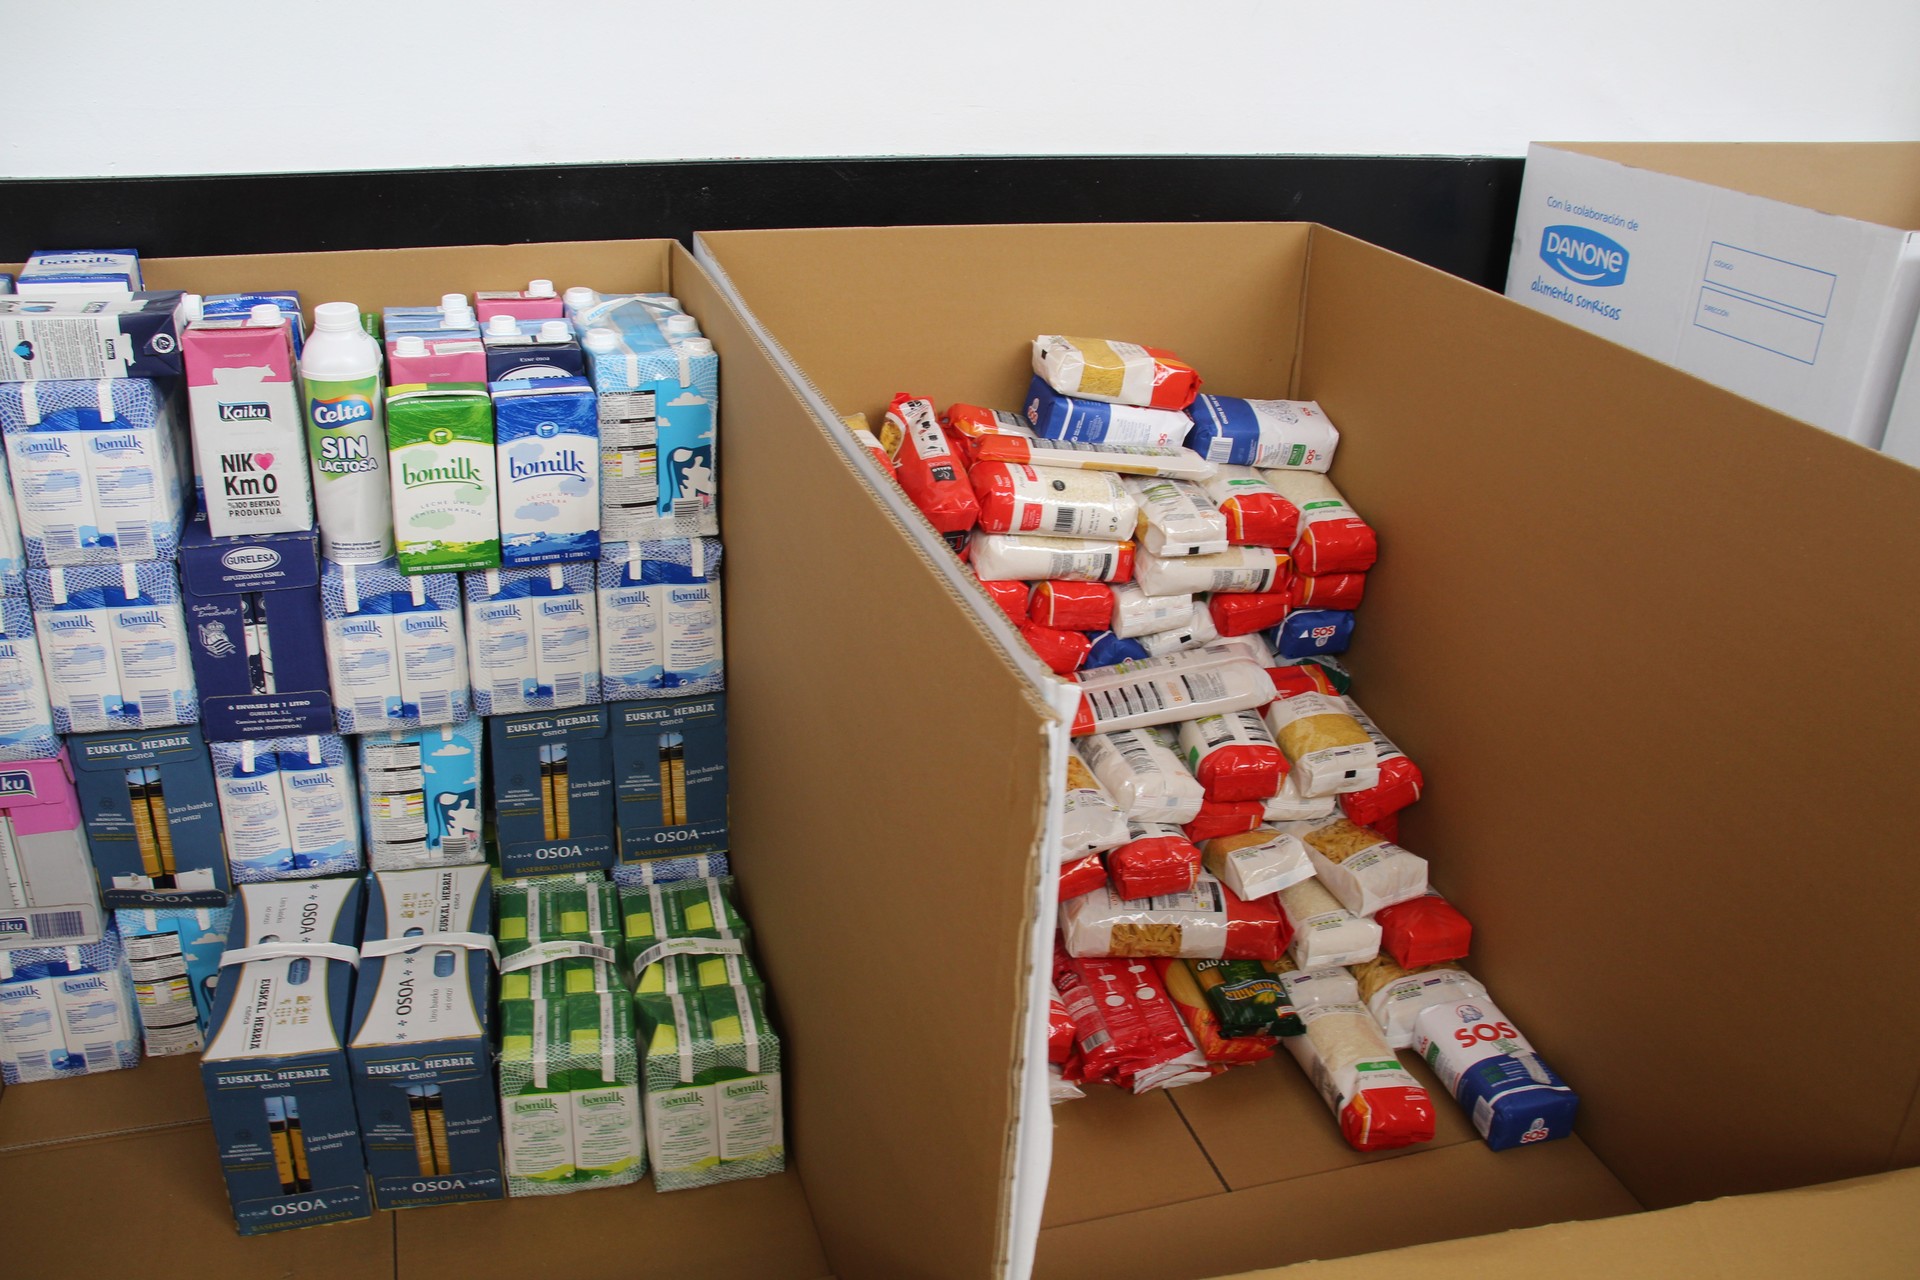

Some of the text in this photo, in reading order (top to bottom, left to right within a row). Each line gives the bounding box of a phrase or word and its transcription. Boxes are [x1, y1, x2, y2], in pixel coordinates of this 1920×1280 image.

[1547, 196, 1639, 232] Con la colaboración de
[40, 257, 117, 266] bomilk
[1531, 276, 1574, 305] alimenta
[223, 405, 267, 420] Kaiku
[314, 404, 368, 424] Celta
[94, 435, 143, 450] bomilk
[320, 435, 369, 460] SIN
[221, 453, 255, 473] NIK
[509, 450, 587, 479] bomilk
[1304, 449, 1316, 465] SOS
[318, 458, 378, 473] LACTOSA
[402, 457, 484, 486] bomilk
[224, 473, 278, 496] Km 0
[250, 500, 281, 508] BERTAKO
[228, 508, 282, 517] PRODUKTUA
[227, 554, 276, 565] GURELESA
[672, 590, 711, 602] bomilk
[543, 599, 584, 613] bomilk
[119, 611, 166, 626] bomilk
[405, 615, 448, 631] bomilk
[1312, 625, 1336, 638] SOS
[625, 703, 715, 721] EUSKAL HERRIA
[506, 715, 599, 733] EUSKAL HERRIA
[660, 718, 684, 727] esnea
[542, 728, 568, 737] esnea
[86, 737, 190, 755] EUSKAL HERRIA
[127, 753, 155, 761] esnea
[293, 773, 334, 787] bomilk
[654, 829, 699, 844] OSOA
[535, 846, 582, 859] OSOA
[140, 893, 192, 903] OSOA
[439, 872, 453, 932] EUSKAL HERRIA
[0, 920, 23, 932] iku
[299, 903, 319, 934] OSOA
[63, 977, 107, 993] bomilk
[0, 986, 40, 1000] omilk
[396, 978, 415, 1016] OSOA
[250, 979, 272, 1050] EUSKAL HERRIA
[1454, 1021, 1518, 1048] SOS
[367, 1057, 475, 1075] EUSKAL HERRIA
[218, 1068, 331, 1085] EUSKAL HERRIA
[408, 1072, 437, 1080] esnea
[261, 1082, 291, 1090] esnea
[727, 1082, 769, 1096] bomilk
[515, 1098, 558, 1111] bomilk
[582, 1092, 625, 1106] bomilk
[1521, 1128, 1549, 1143] SOS
[412, 1180, 466, 1193] OSOA
[271, 1199, 328, 1217] OSOA
